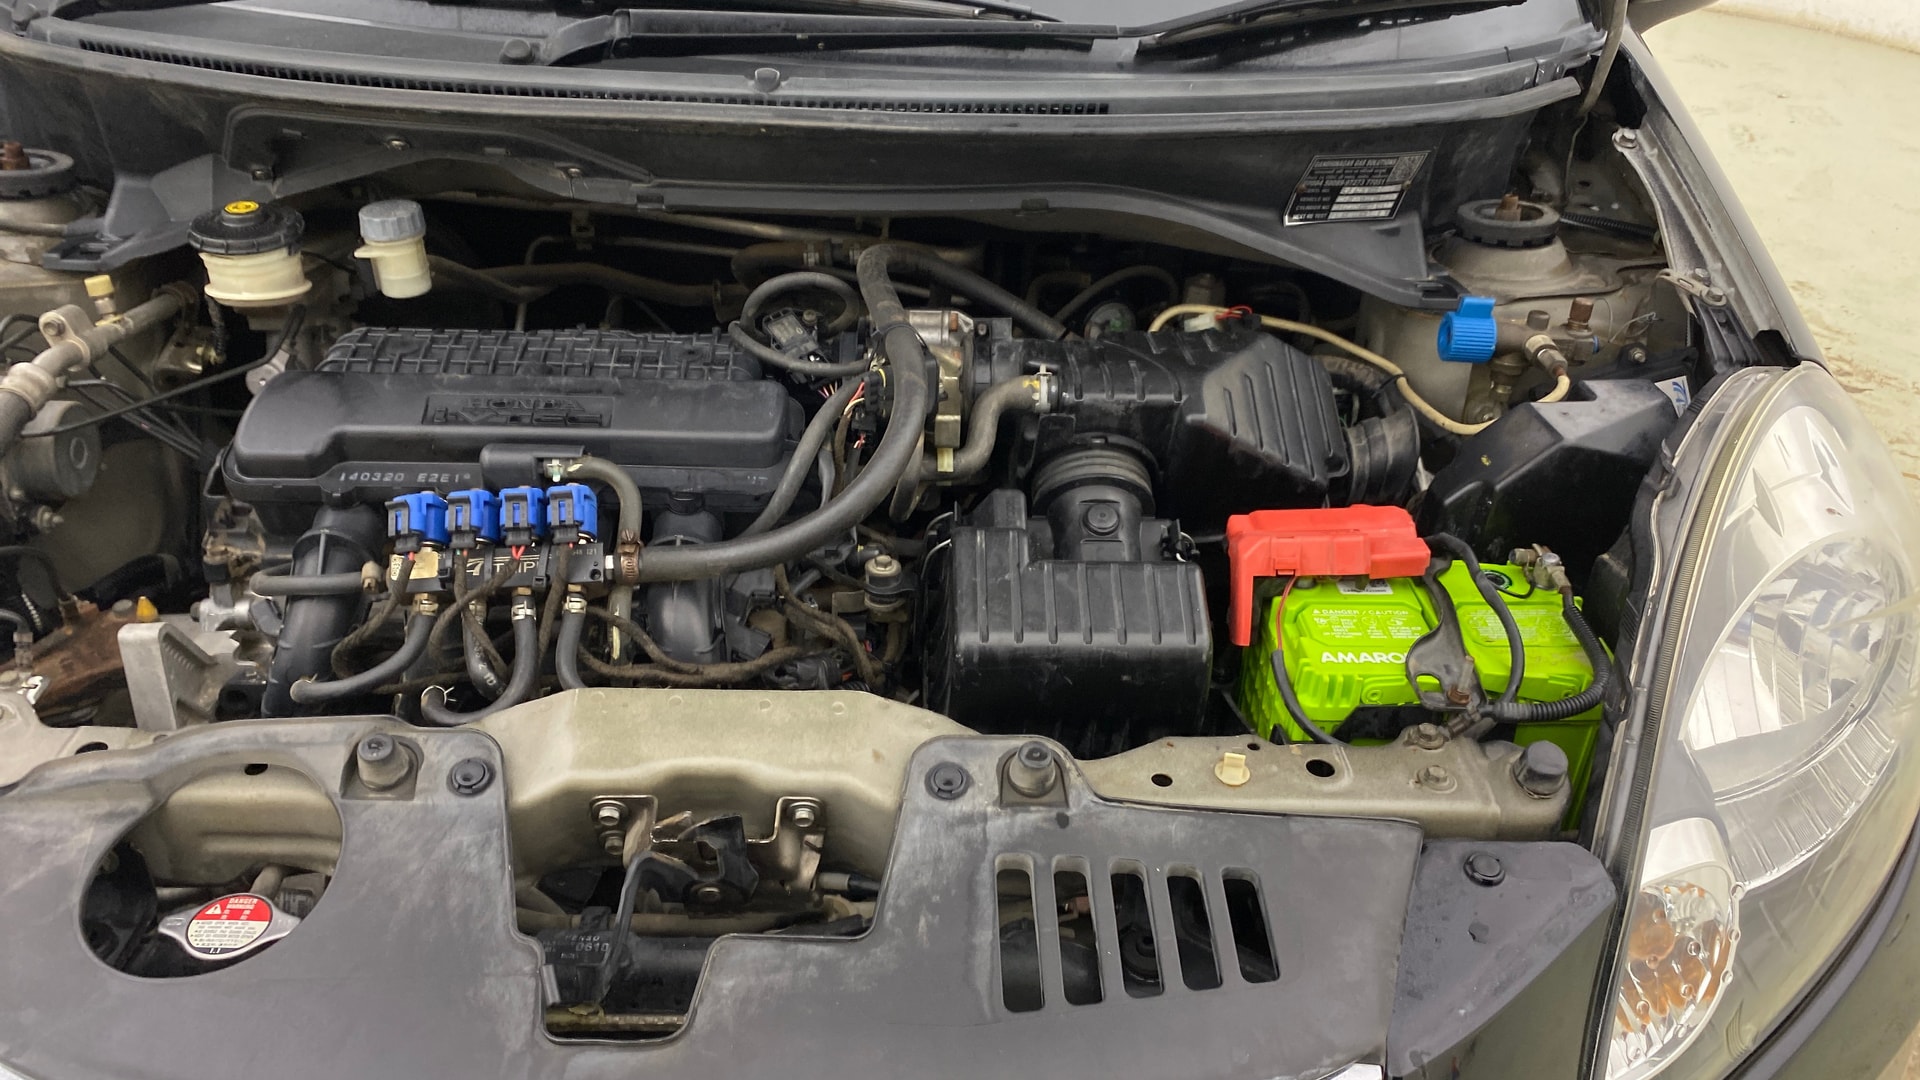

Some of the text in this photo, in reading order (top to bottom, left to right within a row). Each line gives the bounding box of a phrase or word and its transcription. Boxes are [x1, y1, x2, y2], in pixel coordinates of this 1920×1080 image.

[463, 398, 585, 411] HONDA
[339, 472, 405, 482] 140320
[1321, 651, 1407, 664] AMARO
[228, 897, 259, 905] DANGER
